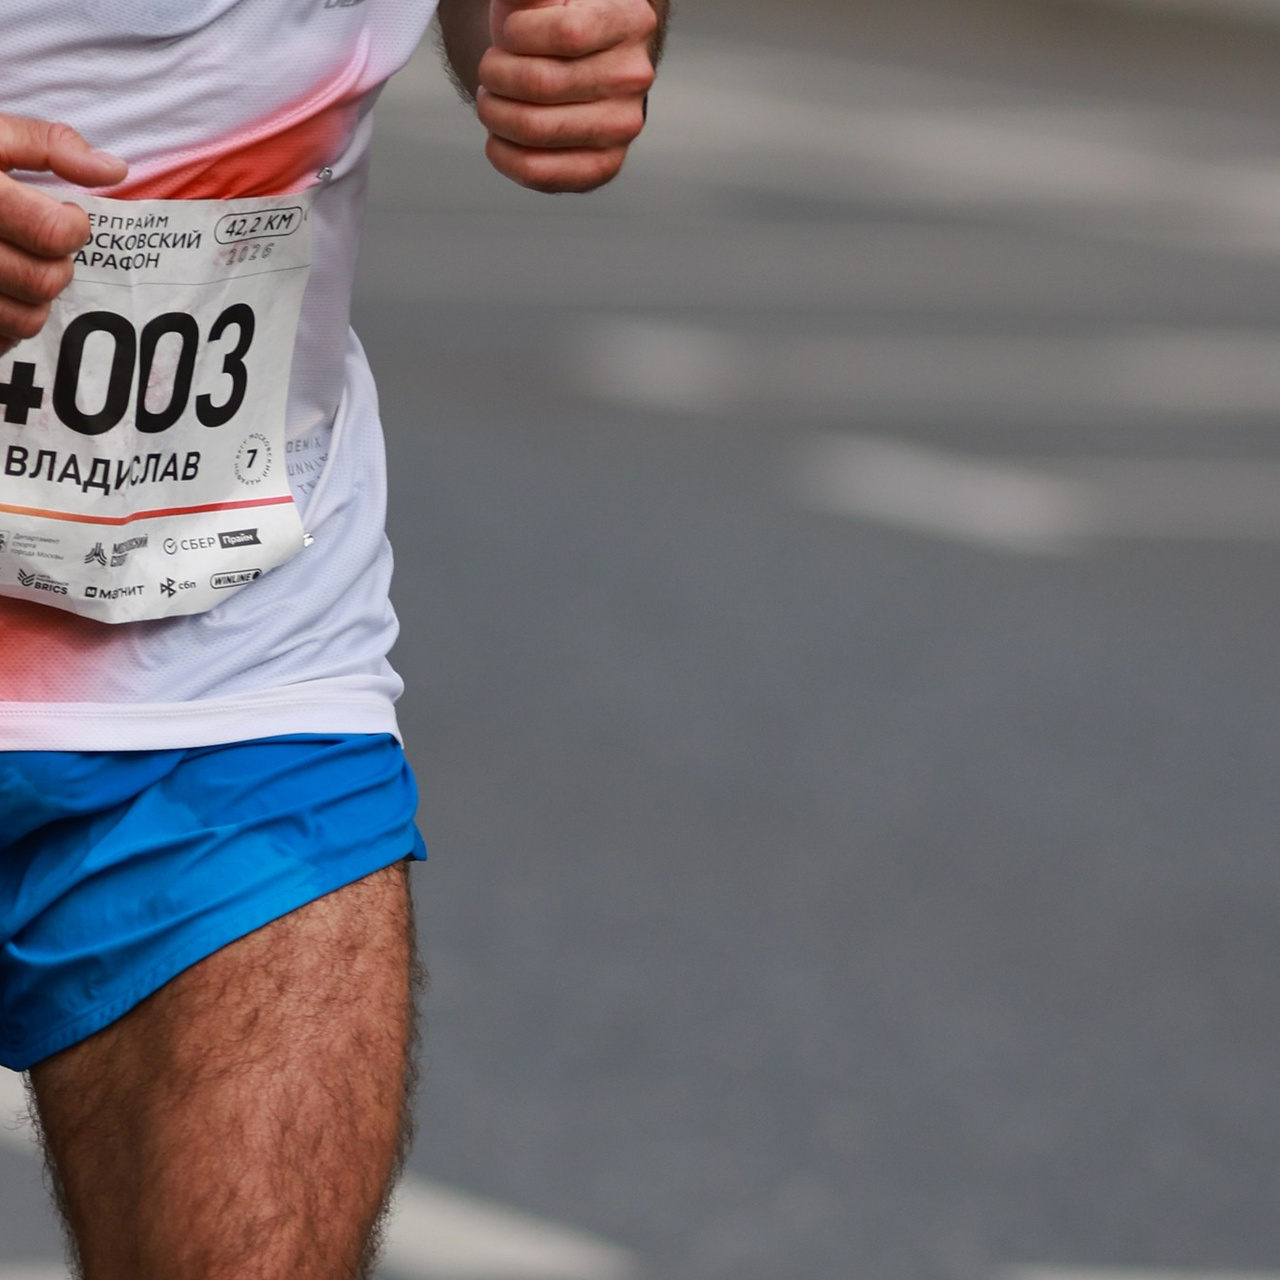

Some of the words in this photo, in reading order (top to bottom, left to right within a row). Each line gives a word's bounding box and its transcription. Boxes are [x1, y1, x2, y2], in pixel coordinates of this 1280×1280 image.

[88, 213, 170, 230] ЕРПРАЙМ
[225, 217, 261, 237] 42,2
[83, 230, 201, 251] СКОВСКИЙ
[73, 250, 161, 271] АРАФОН
[246, 449, 258, 468] 7
[5, 445, 201, 496] ВЛАДИСЛАВ
[180, 537, 216, 551] СБЕР
[34, 581, 69, 595] BRICS
[179, 581, 197, 590] сбп
[214, 573, 252, 587] WINLINE
